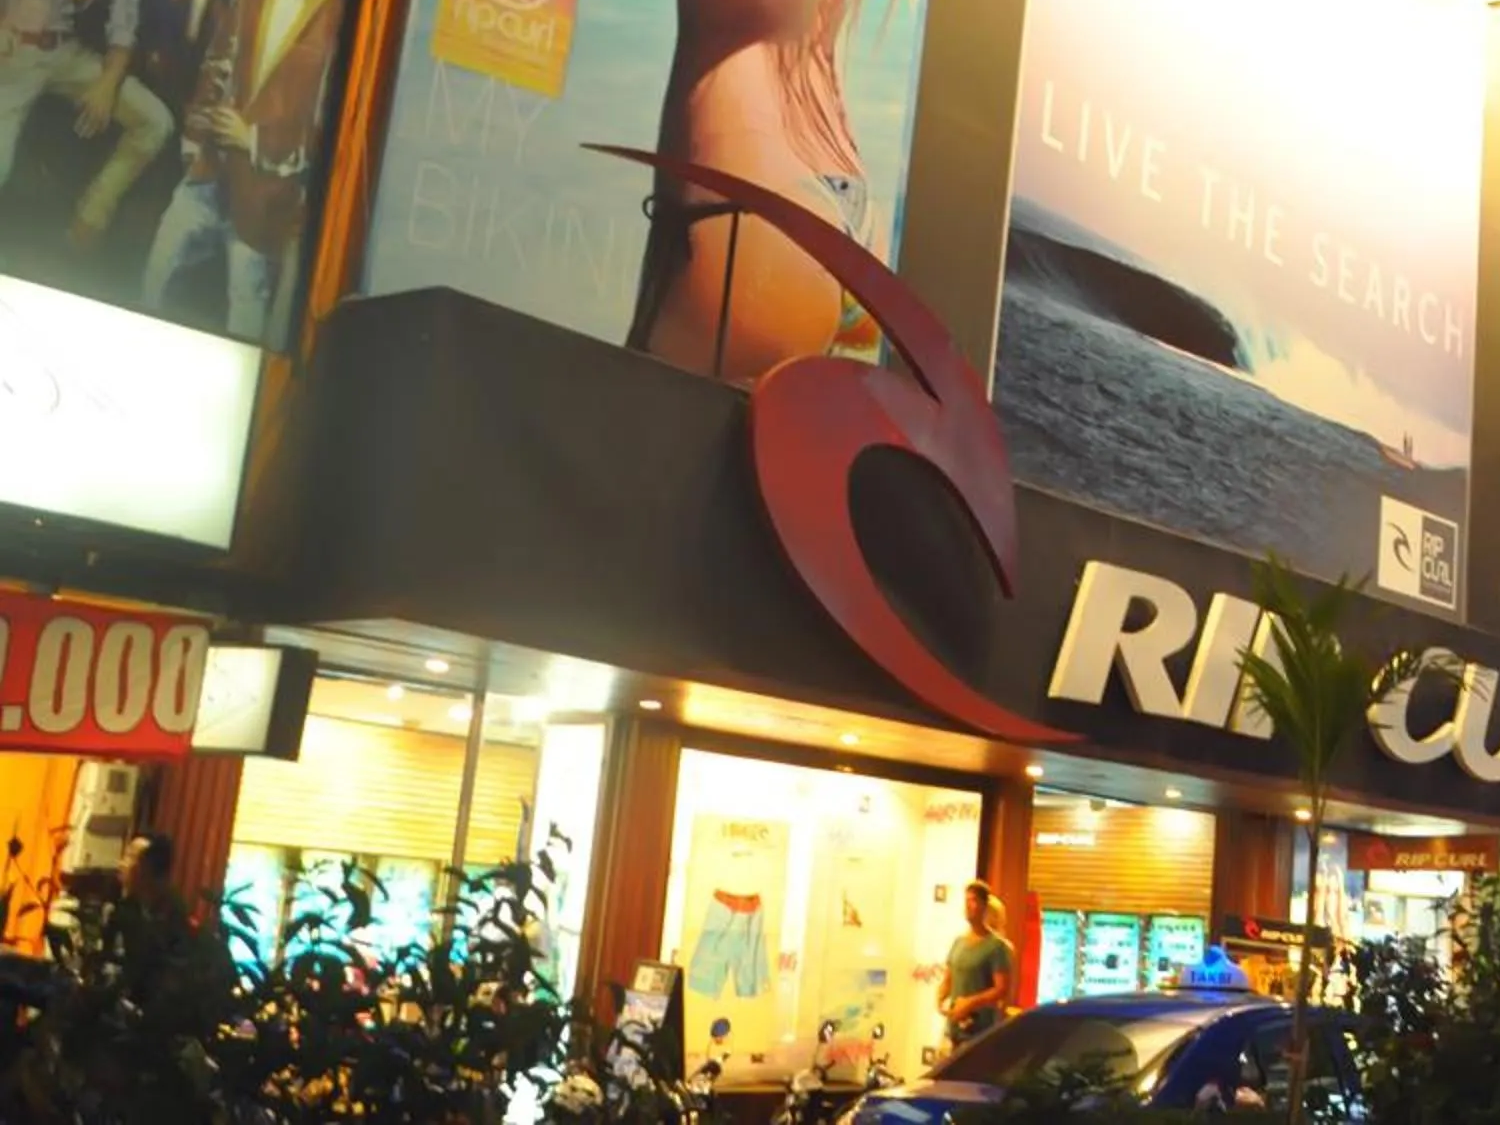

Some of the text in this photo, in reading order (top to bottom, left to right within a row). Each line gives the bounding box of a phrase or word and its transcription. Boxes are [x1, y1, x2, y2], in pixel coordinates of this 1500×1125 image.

[1041, 80, 1466, 359] LIVE THE SEARCH
[1422, 532, 1444, 557] RIP
[1422, 556, 1452, 586] CURL
[1395, 852, 1488, 868] RIP CURL
